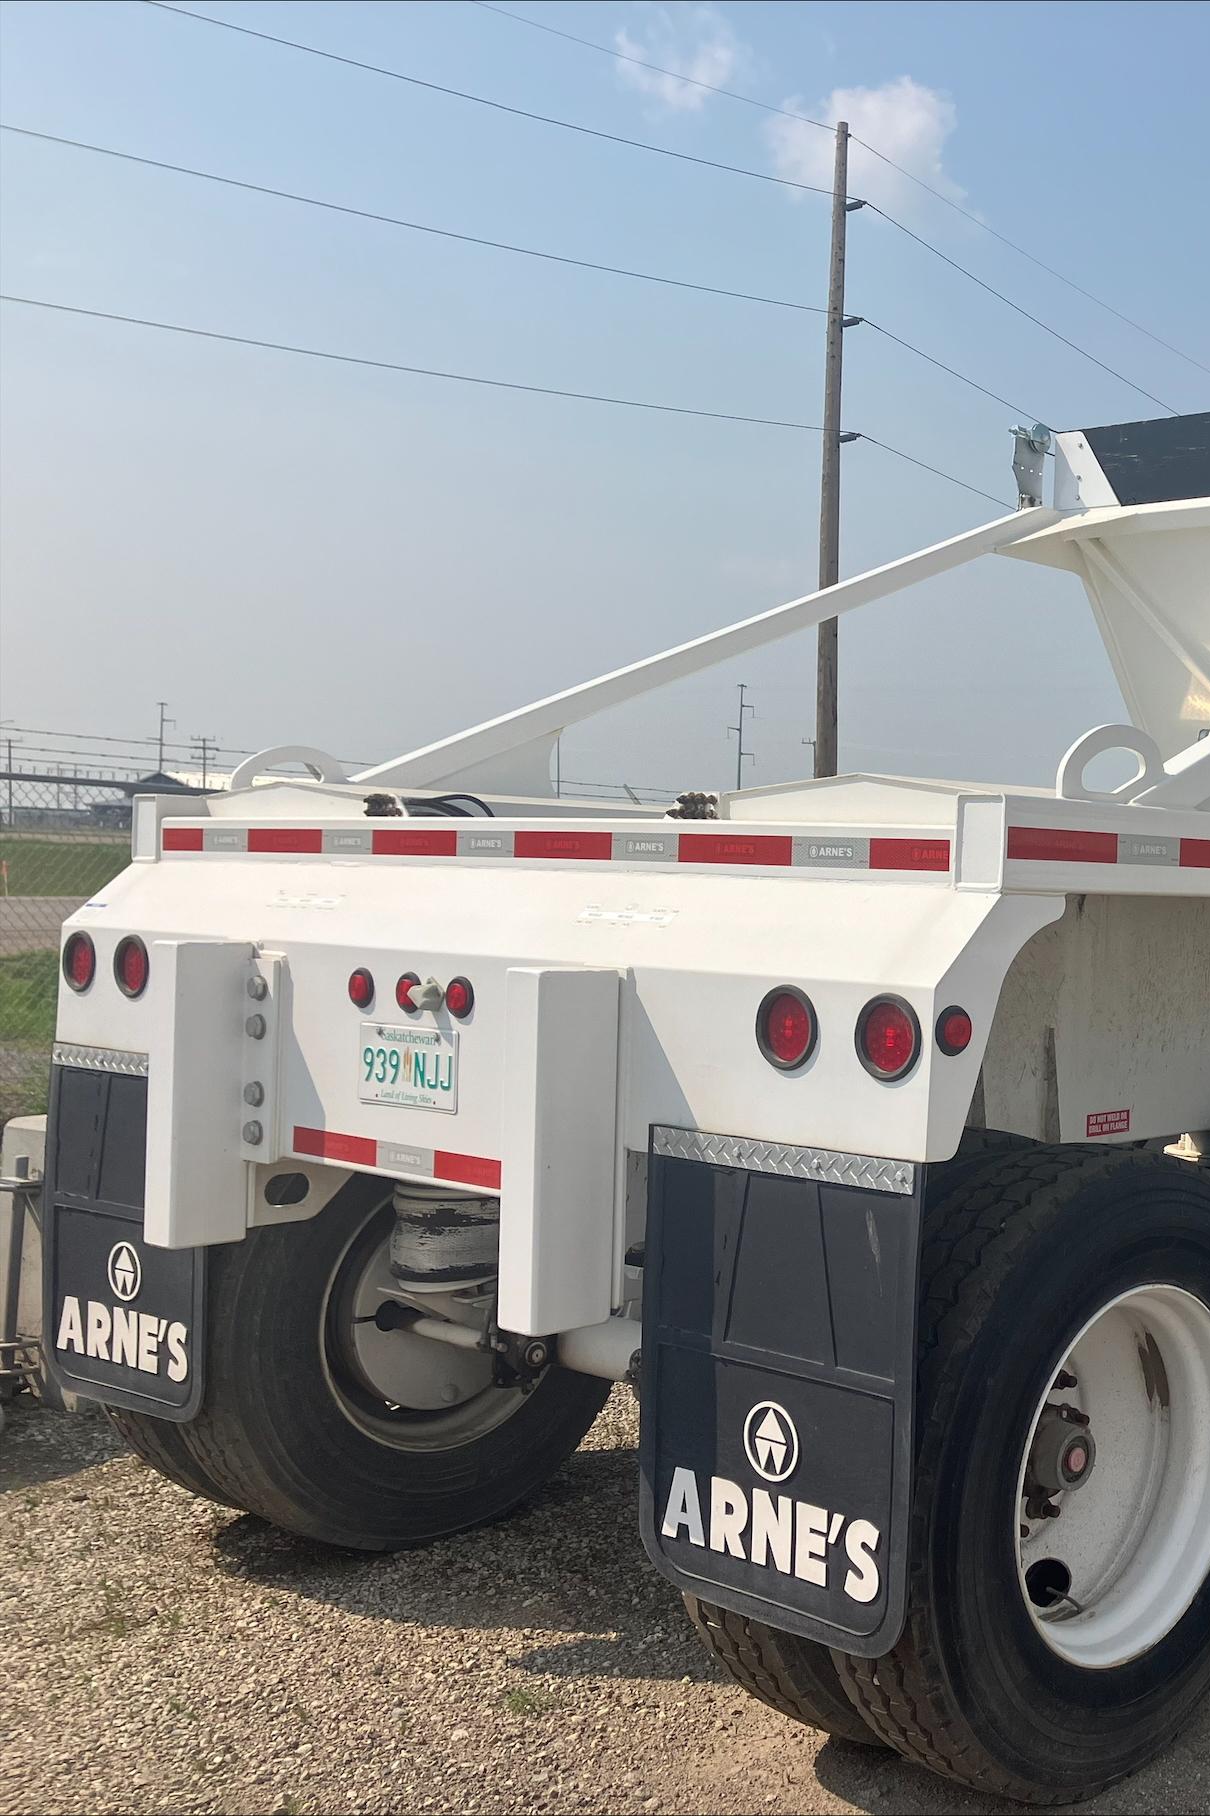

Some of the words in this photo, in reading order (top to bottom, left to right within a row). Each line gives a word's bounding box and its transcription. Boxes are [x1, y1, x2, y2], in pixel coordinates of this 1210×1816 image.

[476, 838, 502, 849] ARNE'S
[634, 841, 665, 853] ARNE'S
[818, 846, 853, 858] ARNE'S
[1139, 844, 1168, 857] ARNE'S
[363, 1046, 401, 1085] 939
[413, 1050, 454, 1091] NJJ
[381, 1089, 395, 1099] Land
[56, 1295, 188, 1383] ARNE'S
[661, 1466, 880, 1603] ARNE'S
